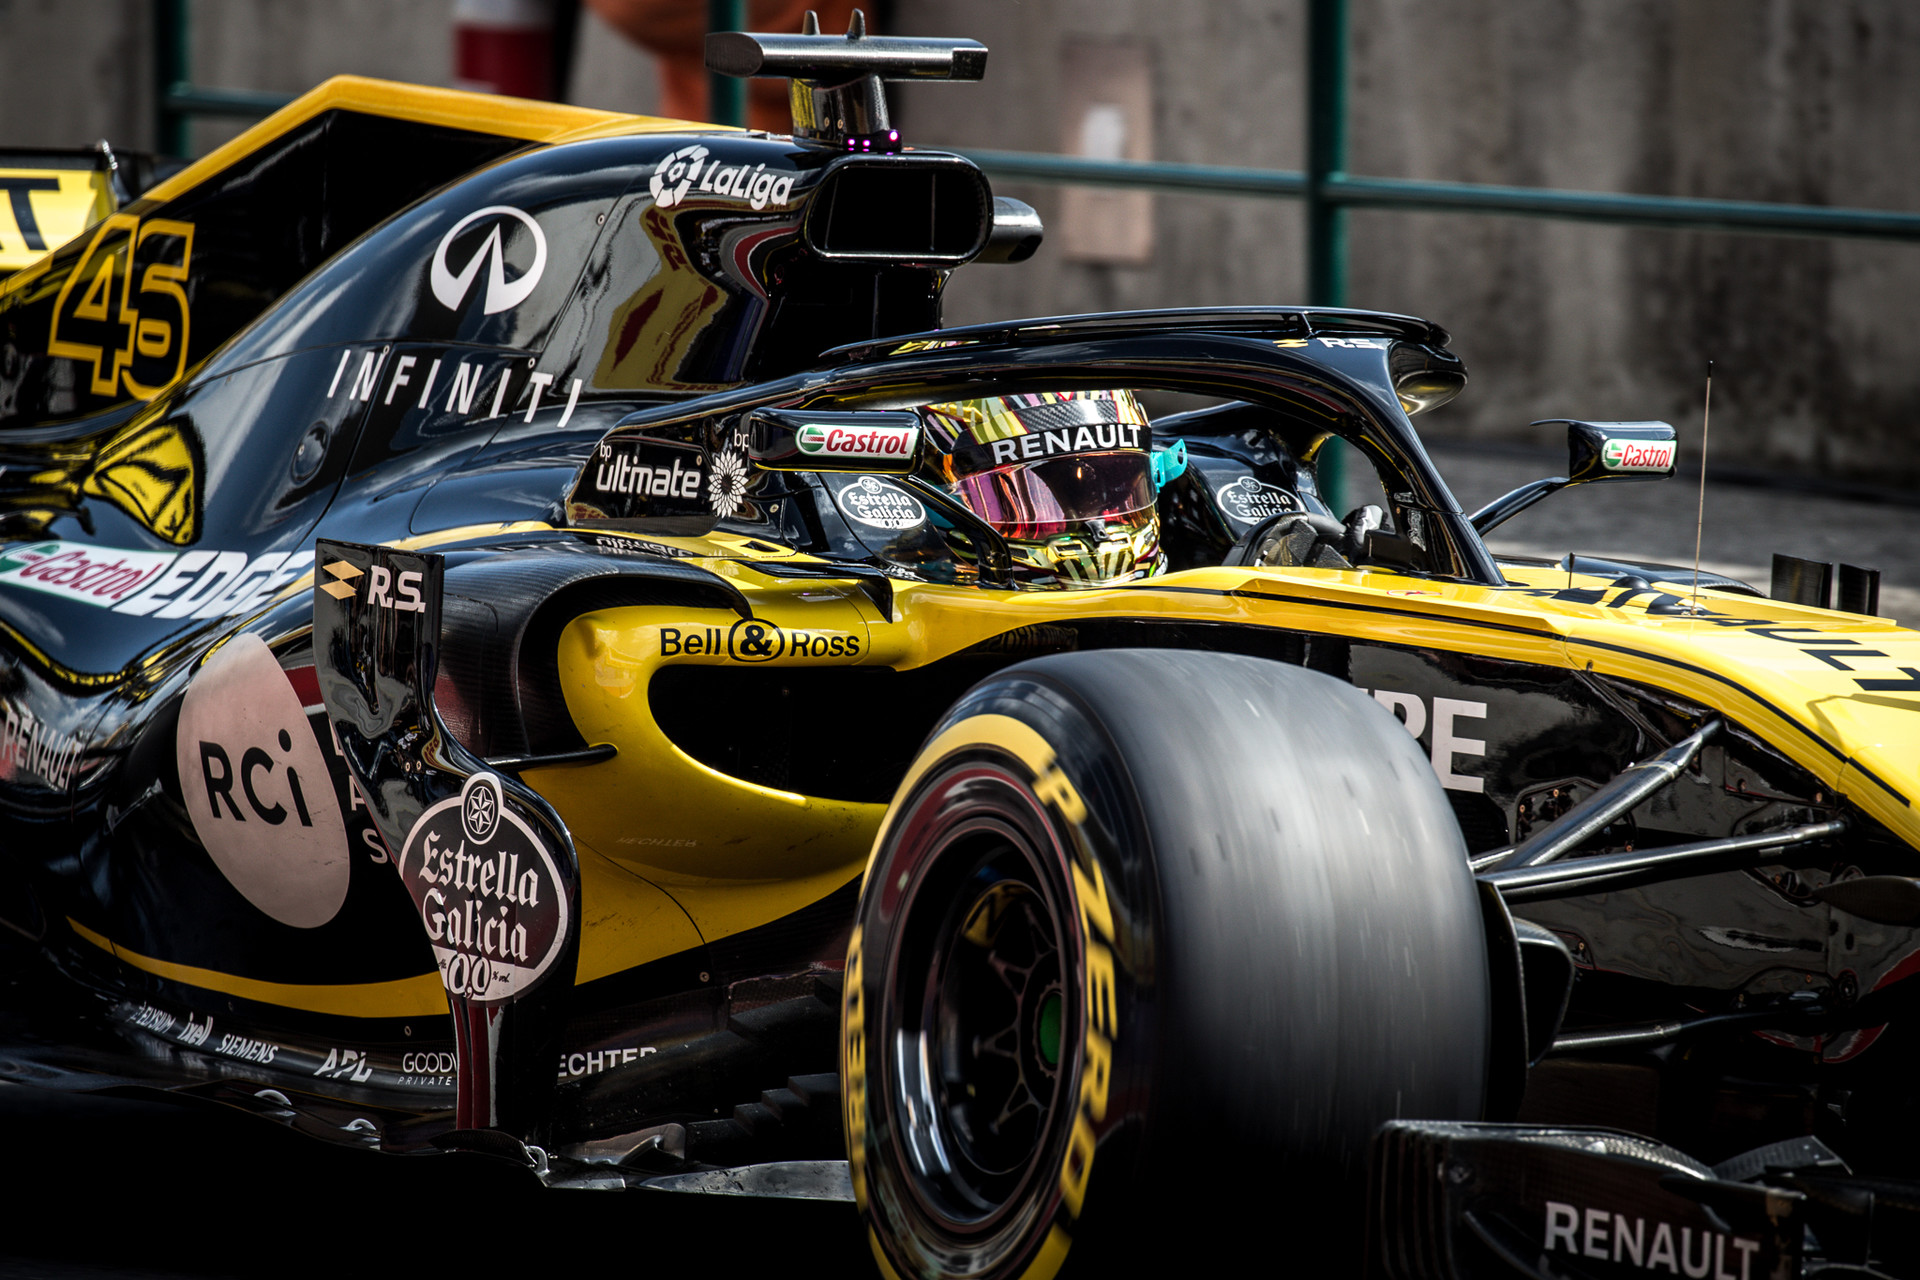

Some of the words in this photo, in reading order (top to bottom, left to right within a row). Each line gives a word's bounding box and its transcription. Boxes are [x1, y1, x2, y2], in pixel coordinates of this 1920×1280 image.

[699, 160, 795, 210] LaLiga
[47, 213, 195, 401] 46
[327, 349, 583, 428] INFINITI
[600, 440, 612, 459] bp
[826, 428, 910, 455] Castrol
[992, 424, 1142, 464] RENAULT
[1621, 443, 1672, 468] Castrol
[595, 453, 701, 498] ultimate
[847, 491, 913, 507] Estrella
[857, 504, 916, 519] Galicia
[1226, 490, 1292, 505] Estrella
[19, 551, 163, 601] Castrol
[111, 550, 316, 620] EDGE
[367, 565, 427, 614] R.S.
[660, 628, 721, 656] Bell
[735, 621, 779, 659] &
[789, 630, 861, 658] Ross
[2, 711, 82, 791] RENAULT
[419, 830, 539, 908] Estrella
[422, 887, 529, 962] Galicia
[215, 1033, 280, 1065] SIEMENS
[1060, 857, 1118, 1220] ZERO
[312, 1047, 373, 1084] APL
[397, 1075, 453, 1087] PRIVATE
[402, 1052, 457, 1074] GOOD
[1544, 1200, 1761, 1280] RENAULT
